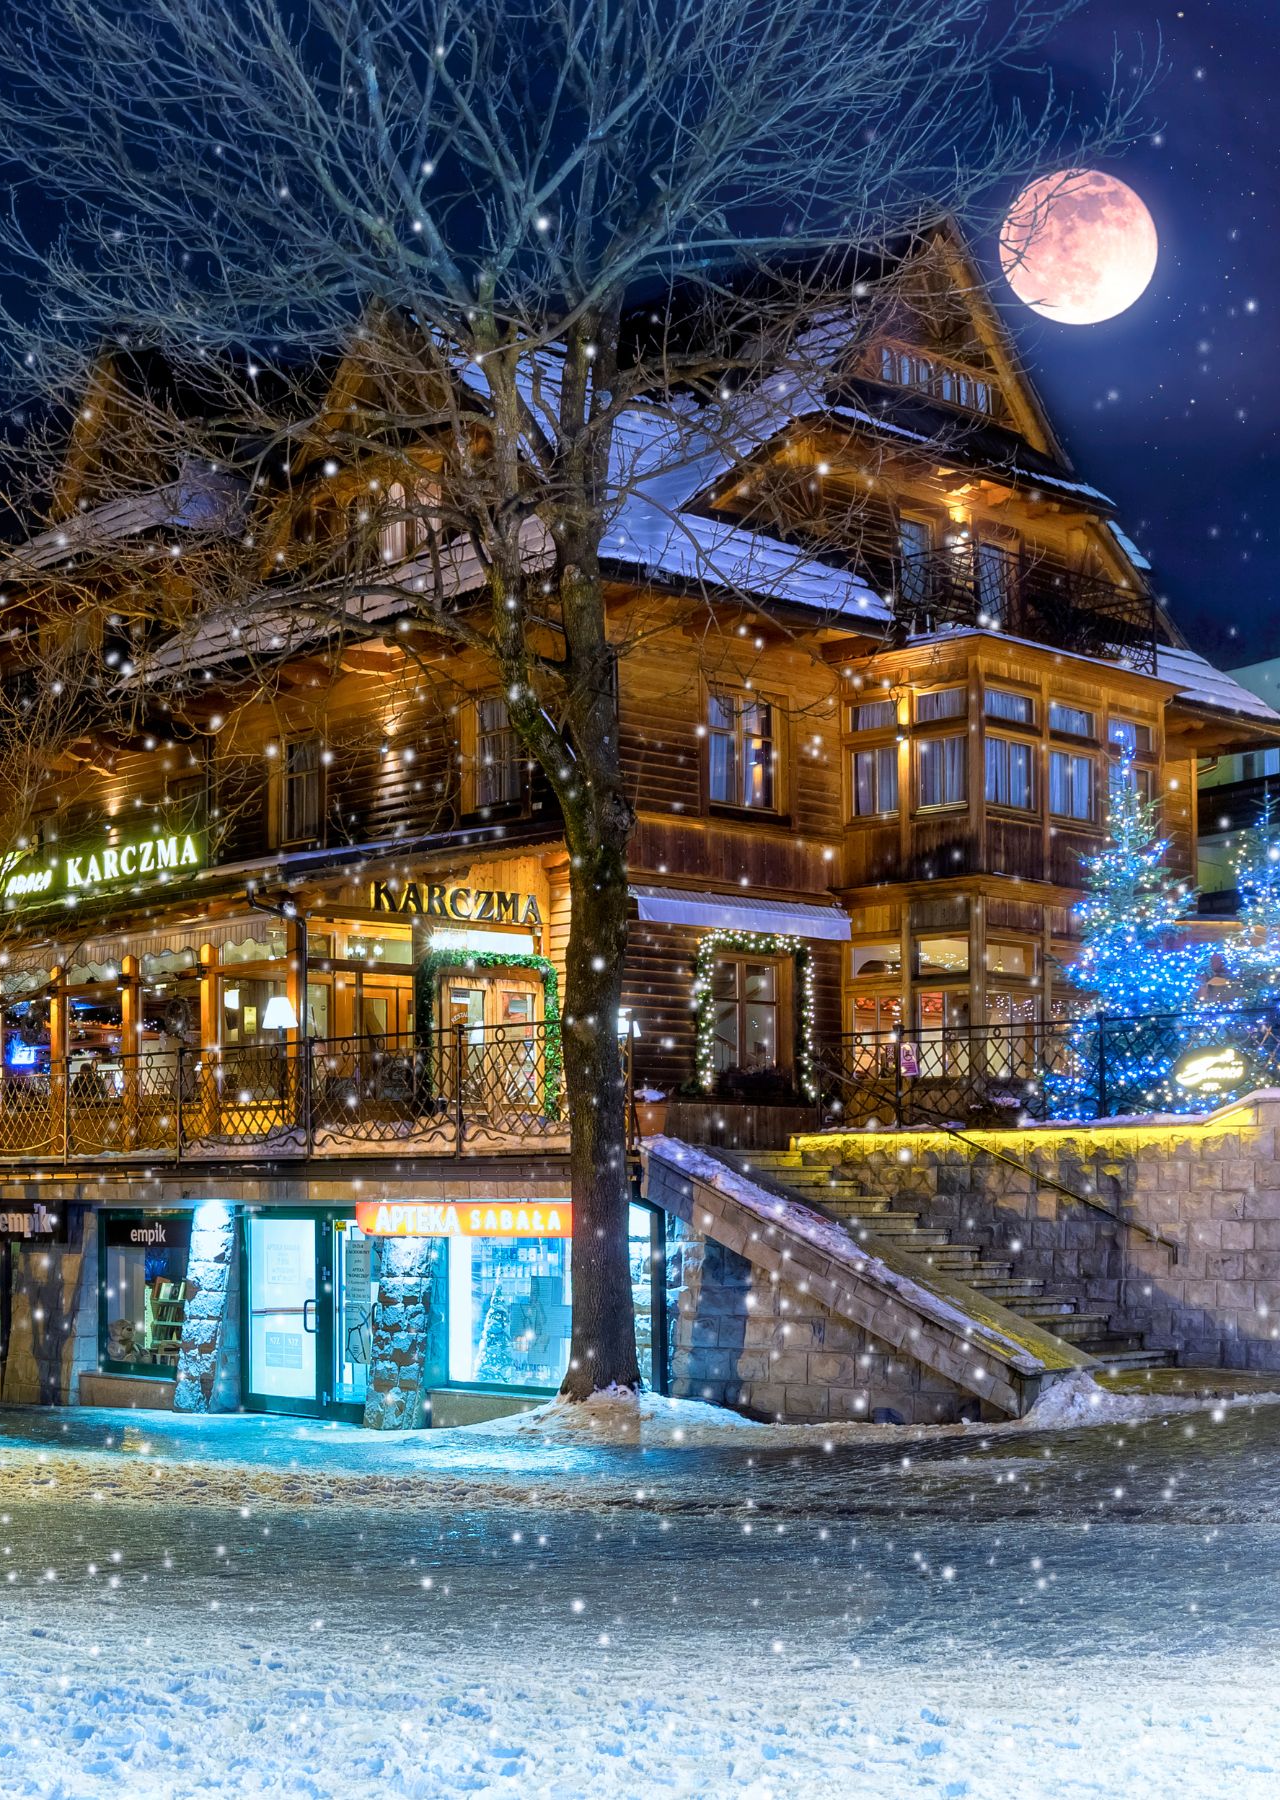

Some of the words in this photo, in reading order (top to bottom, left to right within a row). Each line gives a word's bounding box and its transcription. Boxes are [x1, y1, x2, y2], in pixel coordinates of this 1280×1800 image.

[66, 835, 198, 887] KARCZMA
[372, 881, 543, 925] KARCZMA
[131, 1223, 166, 1245] empik
[375, 1205, 461, 1233] APTEKA
[470, 1210, 561, 1230] SABAŁA
